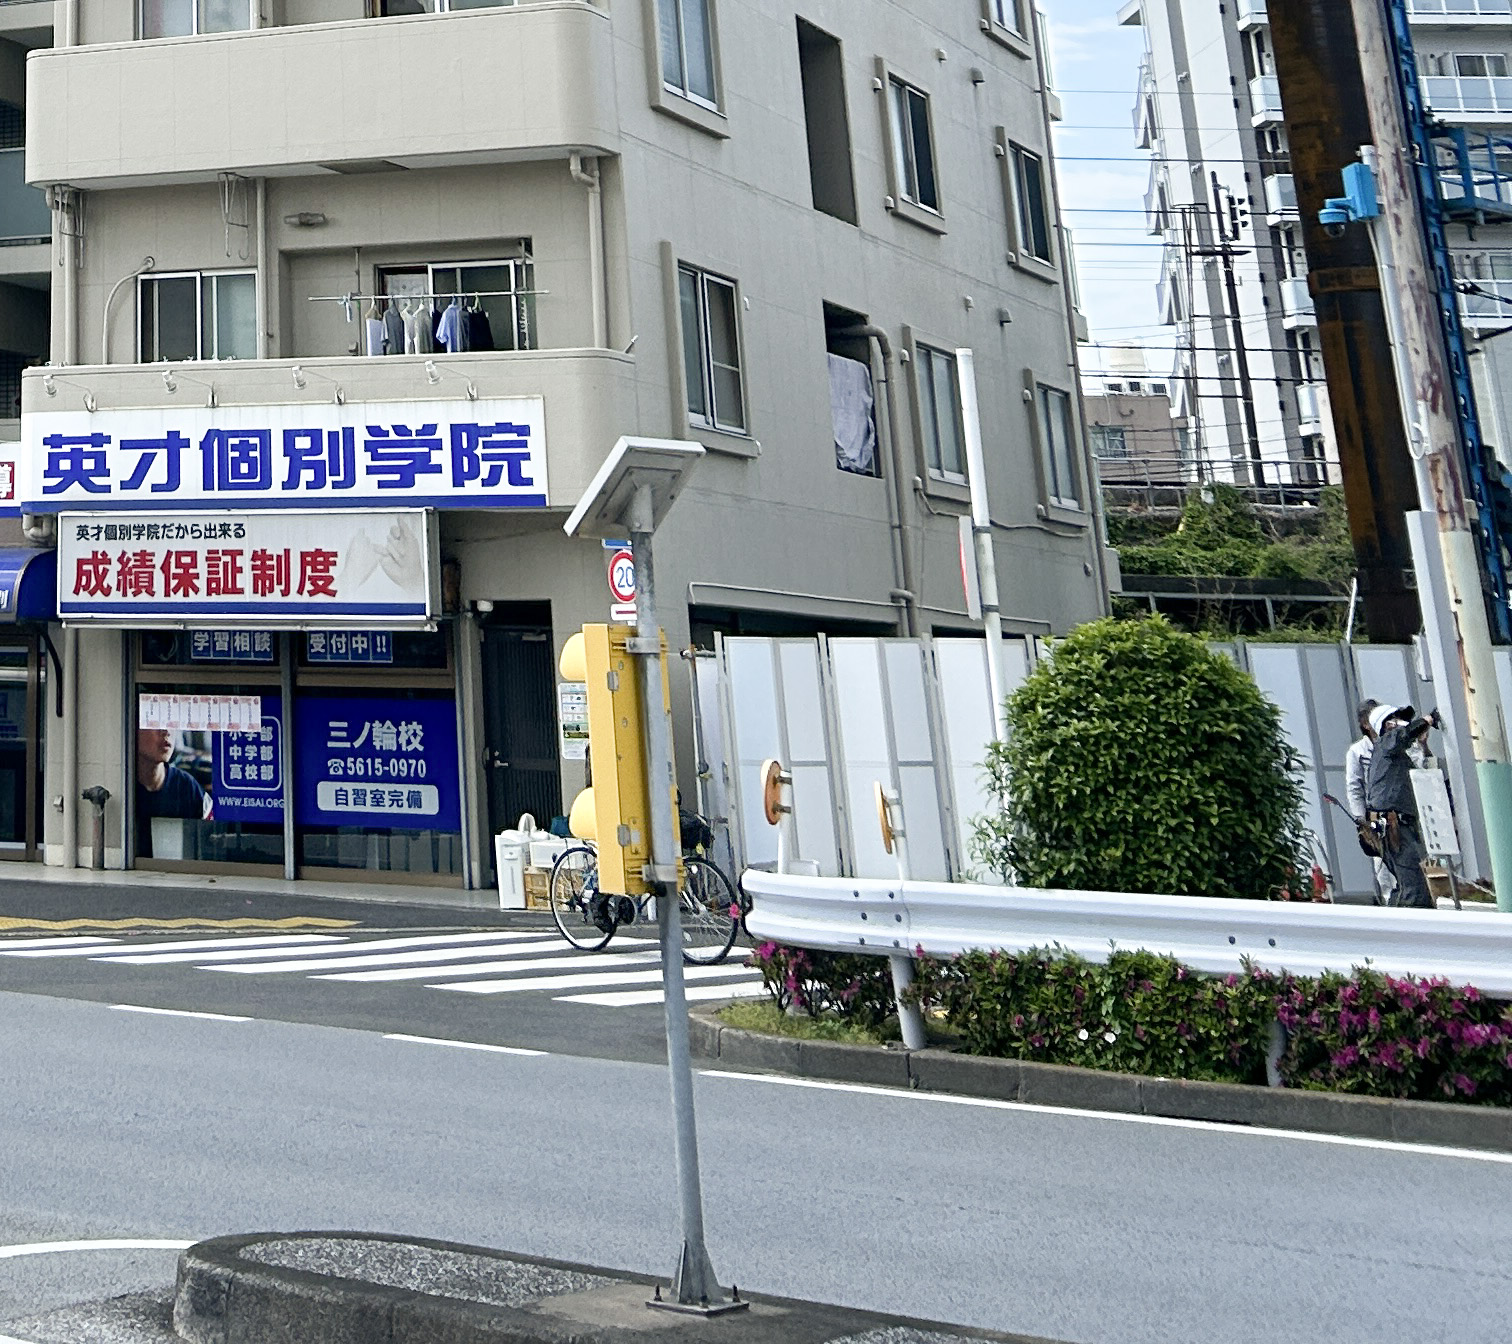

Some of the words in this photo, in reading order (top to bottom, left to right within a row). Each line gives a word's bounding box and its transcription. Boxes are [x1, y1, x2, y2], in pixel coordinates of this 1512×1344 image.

[42, 422, 534, 495] 英才個別学院
[76, 523, 246, 542] 英才個別学院だから出来る
[73, 548, 339, 597] 成績保証制度
[616, 566, 635, 588] 20
[194, 631, 271, 652] 学習相談
[327, 720, 424, 752] 三ノ輪校
[229, 745, 273, 761] 中学部
[229, 764, 273, 781] 高校部
[346, 757, 426, 778] 5615-0970
[335, 787, 422, 809] 自習室完備
